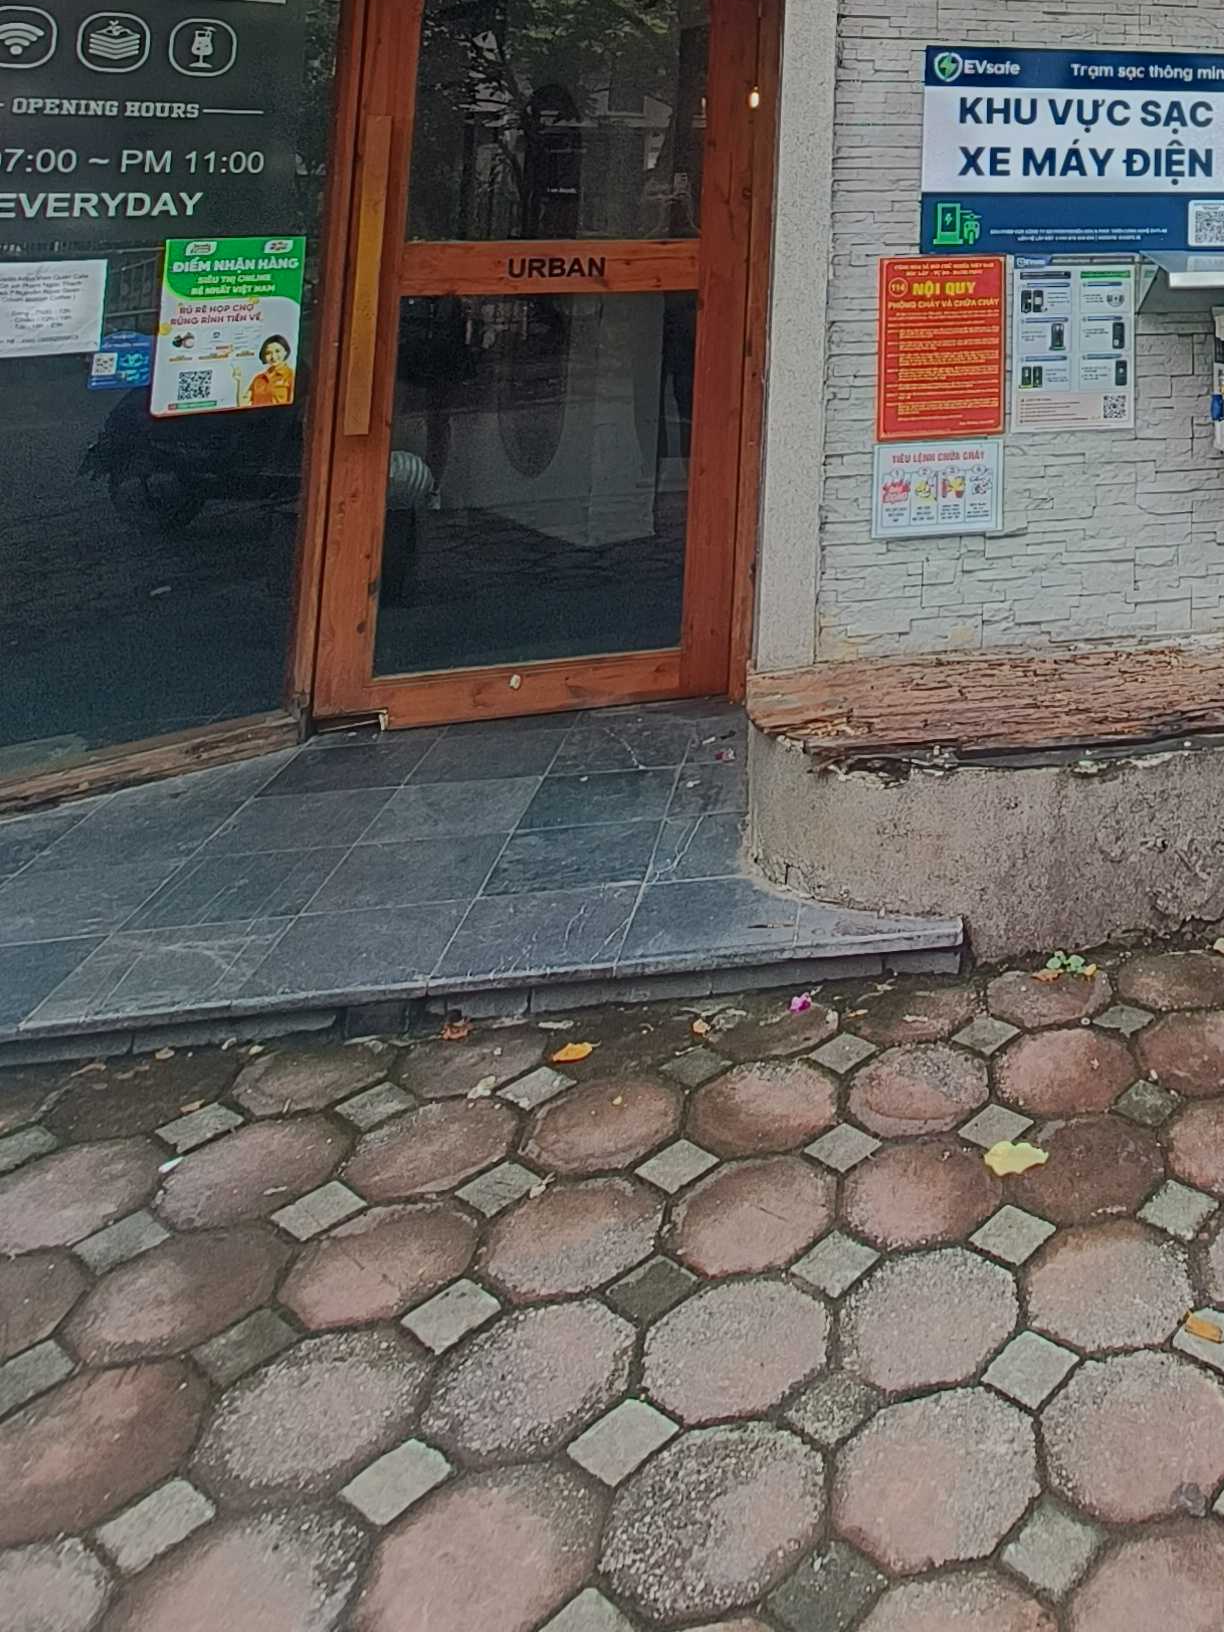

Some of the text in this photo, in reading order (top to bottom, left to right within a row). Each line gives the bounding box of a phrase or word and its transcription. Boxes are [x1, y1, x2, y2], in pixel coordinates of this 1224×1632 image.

[963, 59, 1021, 76] EVsafe
[1070, 62, 1114, 79] Trạm
[1117, 65, 1145, 80] sạc
[1149, 64, 1193, 82] thông
[12, 97, 200, 118] OPENING HOURS
[959, 96, 1214, 135] KHU VỰC SẠC
[0, 148, 78, 172] 7:00
[120, 150, 172, 173] PM
[184, 151, 265, 174] 11:00
[958, 138, 1214, 186] XE MÁY ĐIỆN
[213, 257, 256, 273] NHẬN
[258, 256, 299, 270] HÀNG
[507, 256, 606, 279] URBAN
[911, 280, 941, 298] NỘI
[945, 281, 976, 296] QUY
